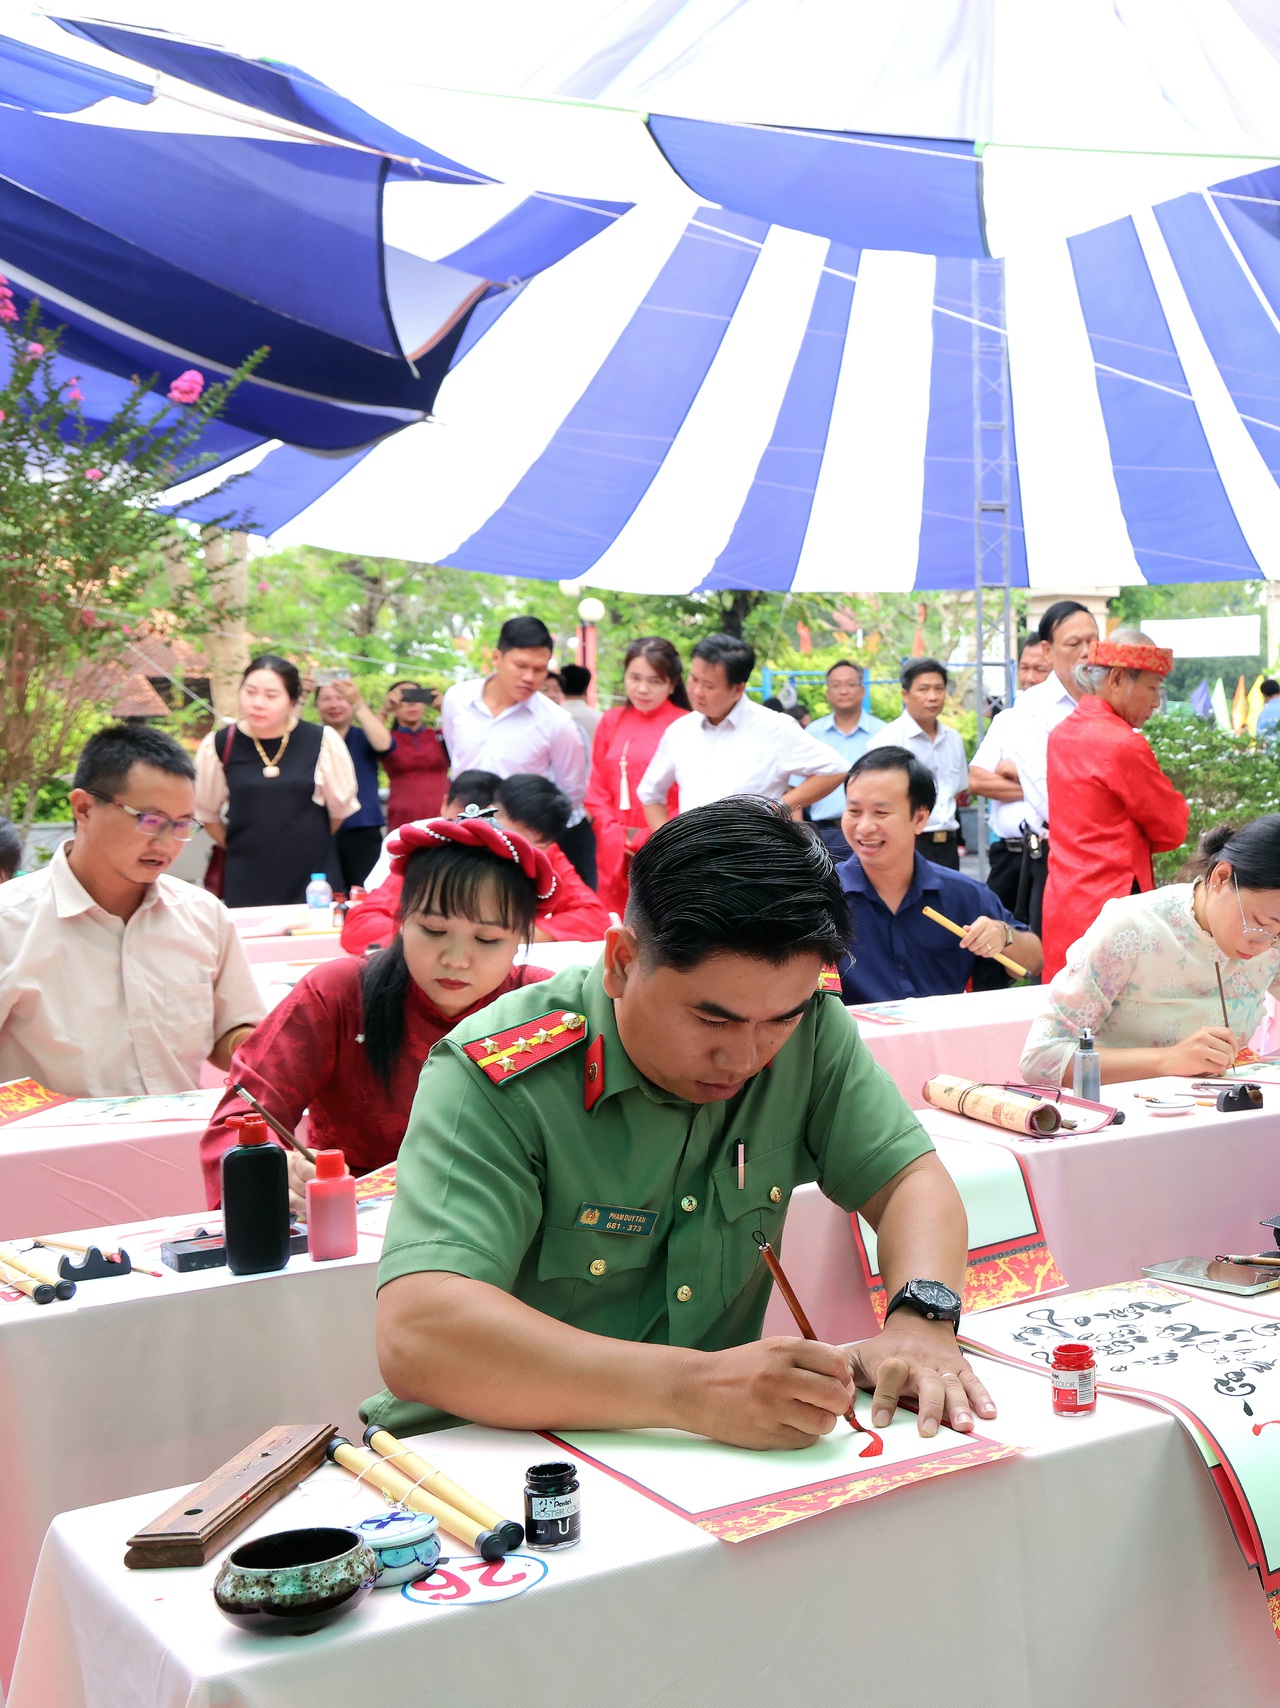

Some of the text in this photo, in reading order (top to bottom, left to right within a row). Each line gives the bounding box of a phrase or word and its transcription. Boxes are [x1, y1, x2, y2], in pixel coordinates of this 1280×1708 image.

[627, 1224, 642, 1232] 373
[554, 1499, 572, 1508] Pentel
[534, 1508, 565, 1518] POSTER
[411, 1557, 527, 1601] 26
